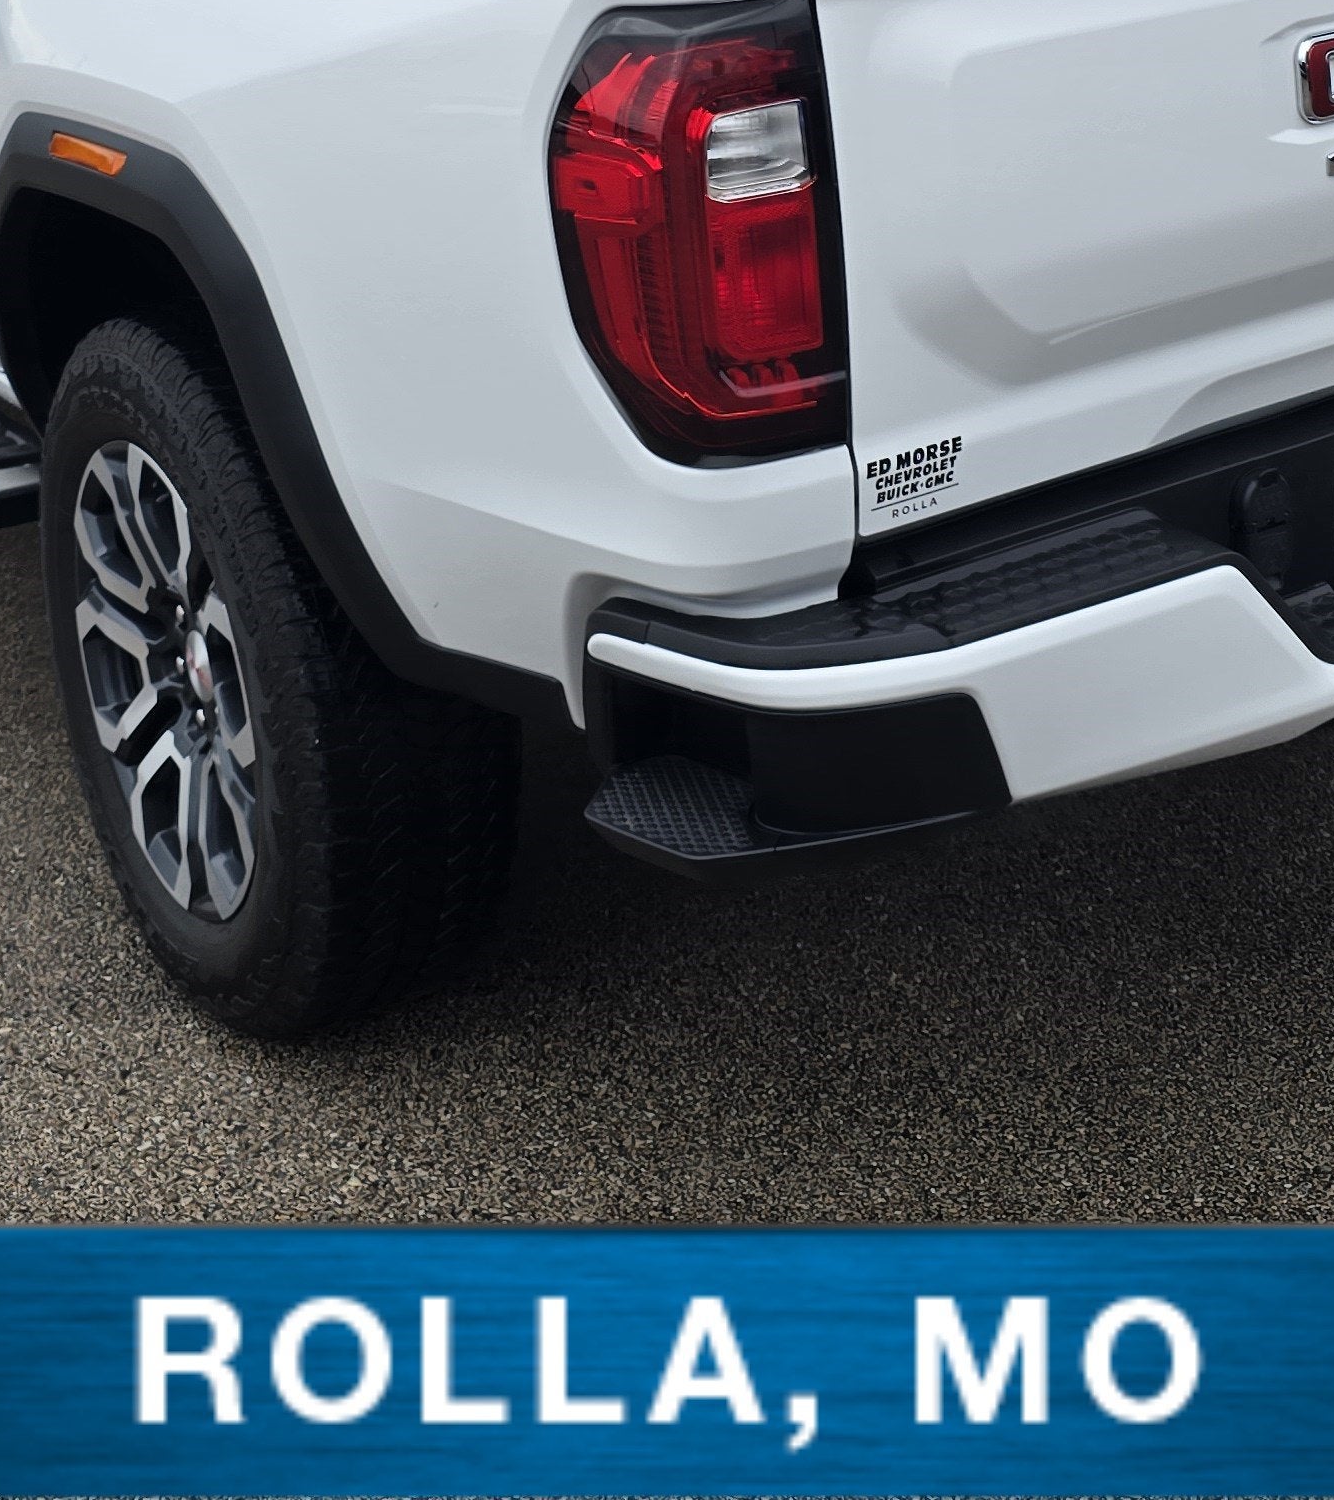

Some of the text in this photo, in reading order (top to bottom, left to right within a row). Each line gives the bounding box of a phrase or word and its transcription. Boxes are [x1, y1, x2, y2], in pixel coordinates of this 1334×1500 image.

[867, 436, 962, 479] ED MORSE
[875, 455, 957, 490] CHEVROLET
[892, 497, 938, 519] ROLLA
